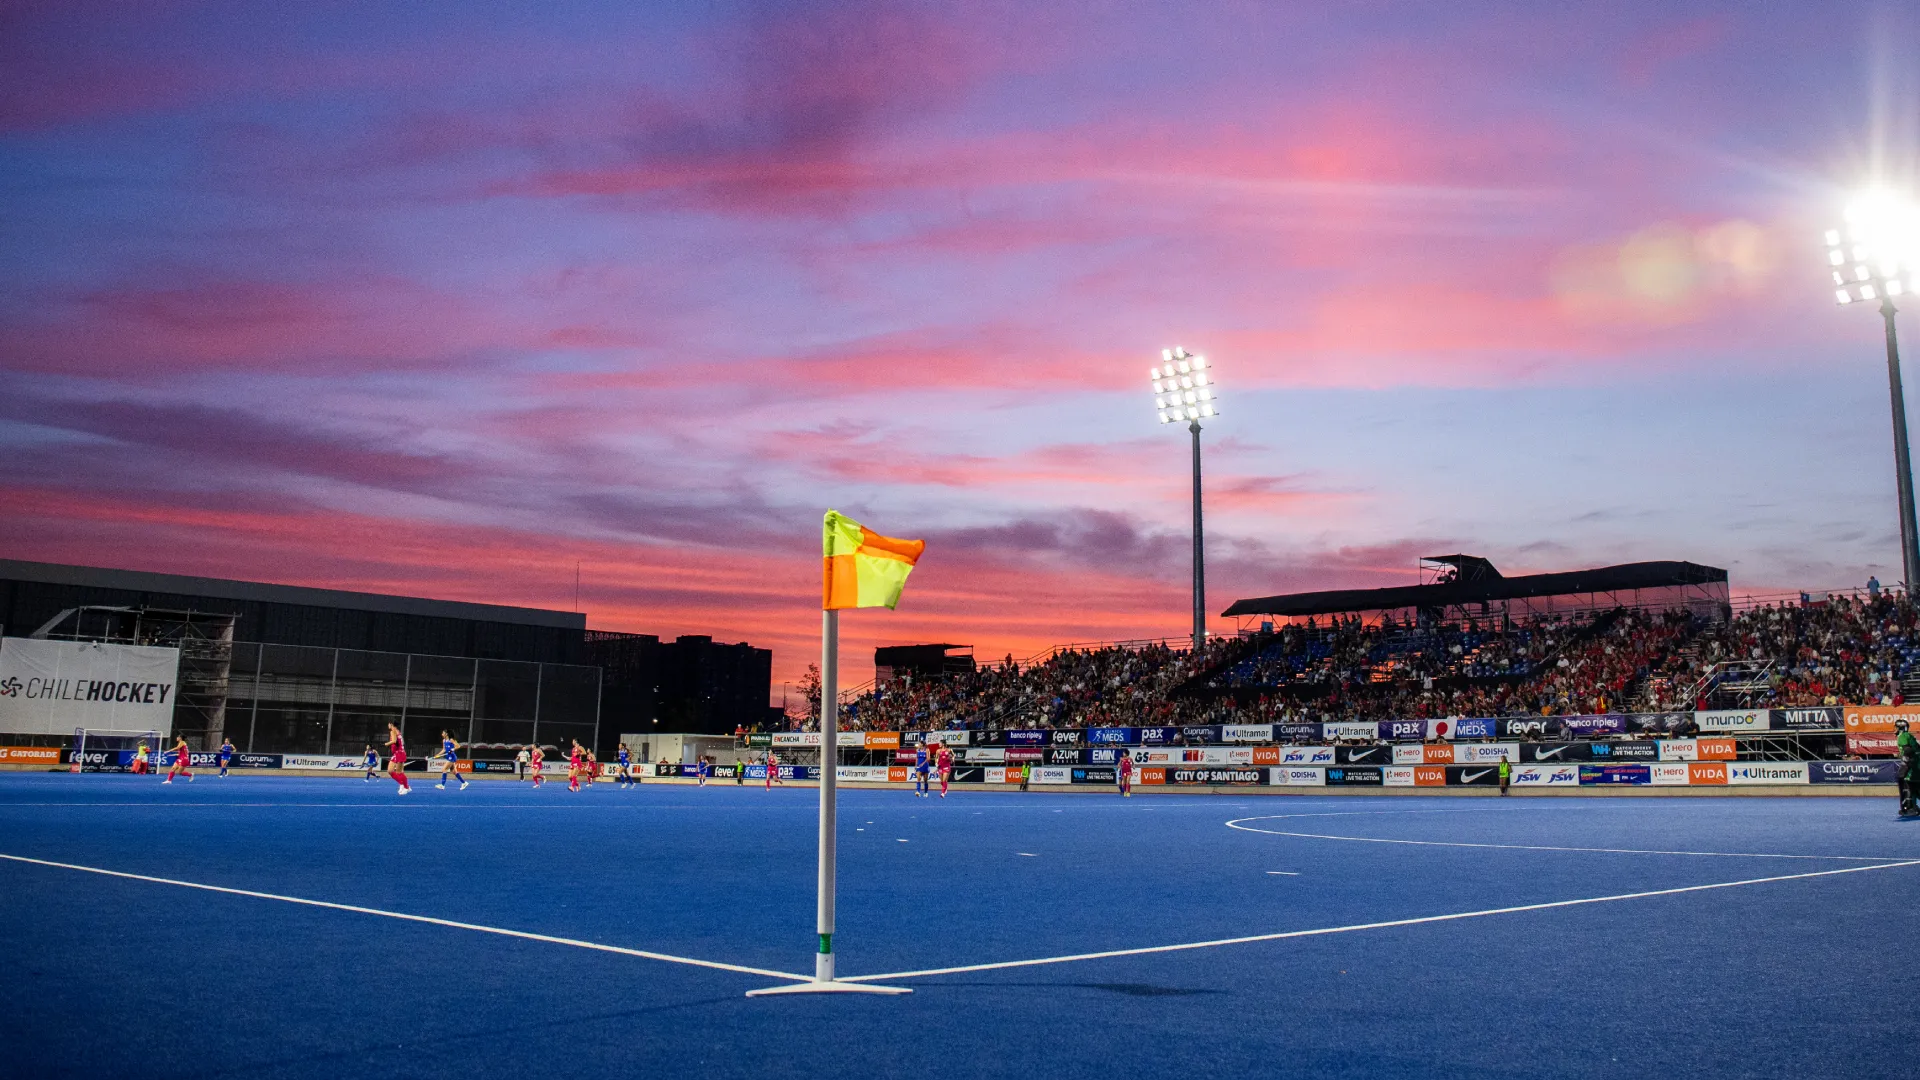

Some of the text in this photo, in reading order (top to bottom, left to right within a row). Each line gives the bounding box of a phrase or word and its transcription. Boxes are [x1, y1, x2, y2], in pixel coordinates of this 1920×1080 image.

[26, 677, 172, 704] CHILEHOCKEY
[1785, 709, 1830, 723] MITTA
[1506, 719, 1547, 734] fever
[1565, 717, 1618, 728] banco ripley
[1141, 728, 1164, 741] pax
[1236, 729, 1269, 738] Ultramar
[1338, 727, 1374, 736] Ultramar
[1392, 722, 1420, 737] pax
[1456, 725, 1487, 735] MEDS
[804, 735, 820, 744] FLES
[1052, 730, 1080, 743] fever
[1102, 733, 1124, 741] MEDS
[10, 750, 58, 758] GATORADE
[1427, 750, 1452, 758] VIDA
[1479, 747, 1509, 755] ODISHA
[1701, 745, 1733, 754] VIDA
[189, 753, 217, 766] pax
[1255, 752, 1278, 760] VIDA
[1283, 753, 1305, 763] JSW
[1310, 753, 1333, 763] JSW
[296, 758, 330, 767] Ultramar
[714, 766, 735, 777] fever
[777, 766, 794, 777] pax
[844, 769, 868, 778] Ultramar
[1693, 769, 1725, 779] VIDA
[1749, 767, 1803, 779] Ultramar
[1822, 762, 1869, 776] Cuprum
[1143, 772, 1164, 780] VIDA
[1174, 771, 1260, 781] CITY OF SANTIAGO
[1290, 771, 1317, 779] ODISHA
[1418, 772, 1443, 780] VIDA
[1513, 773, 1542, 784] JSW
[1546, 773, 1576, 784] JSW
